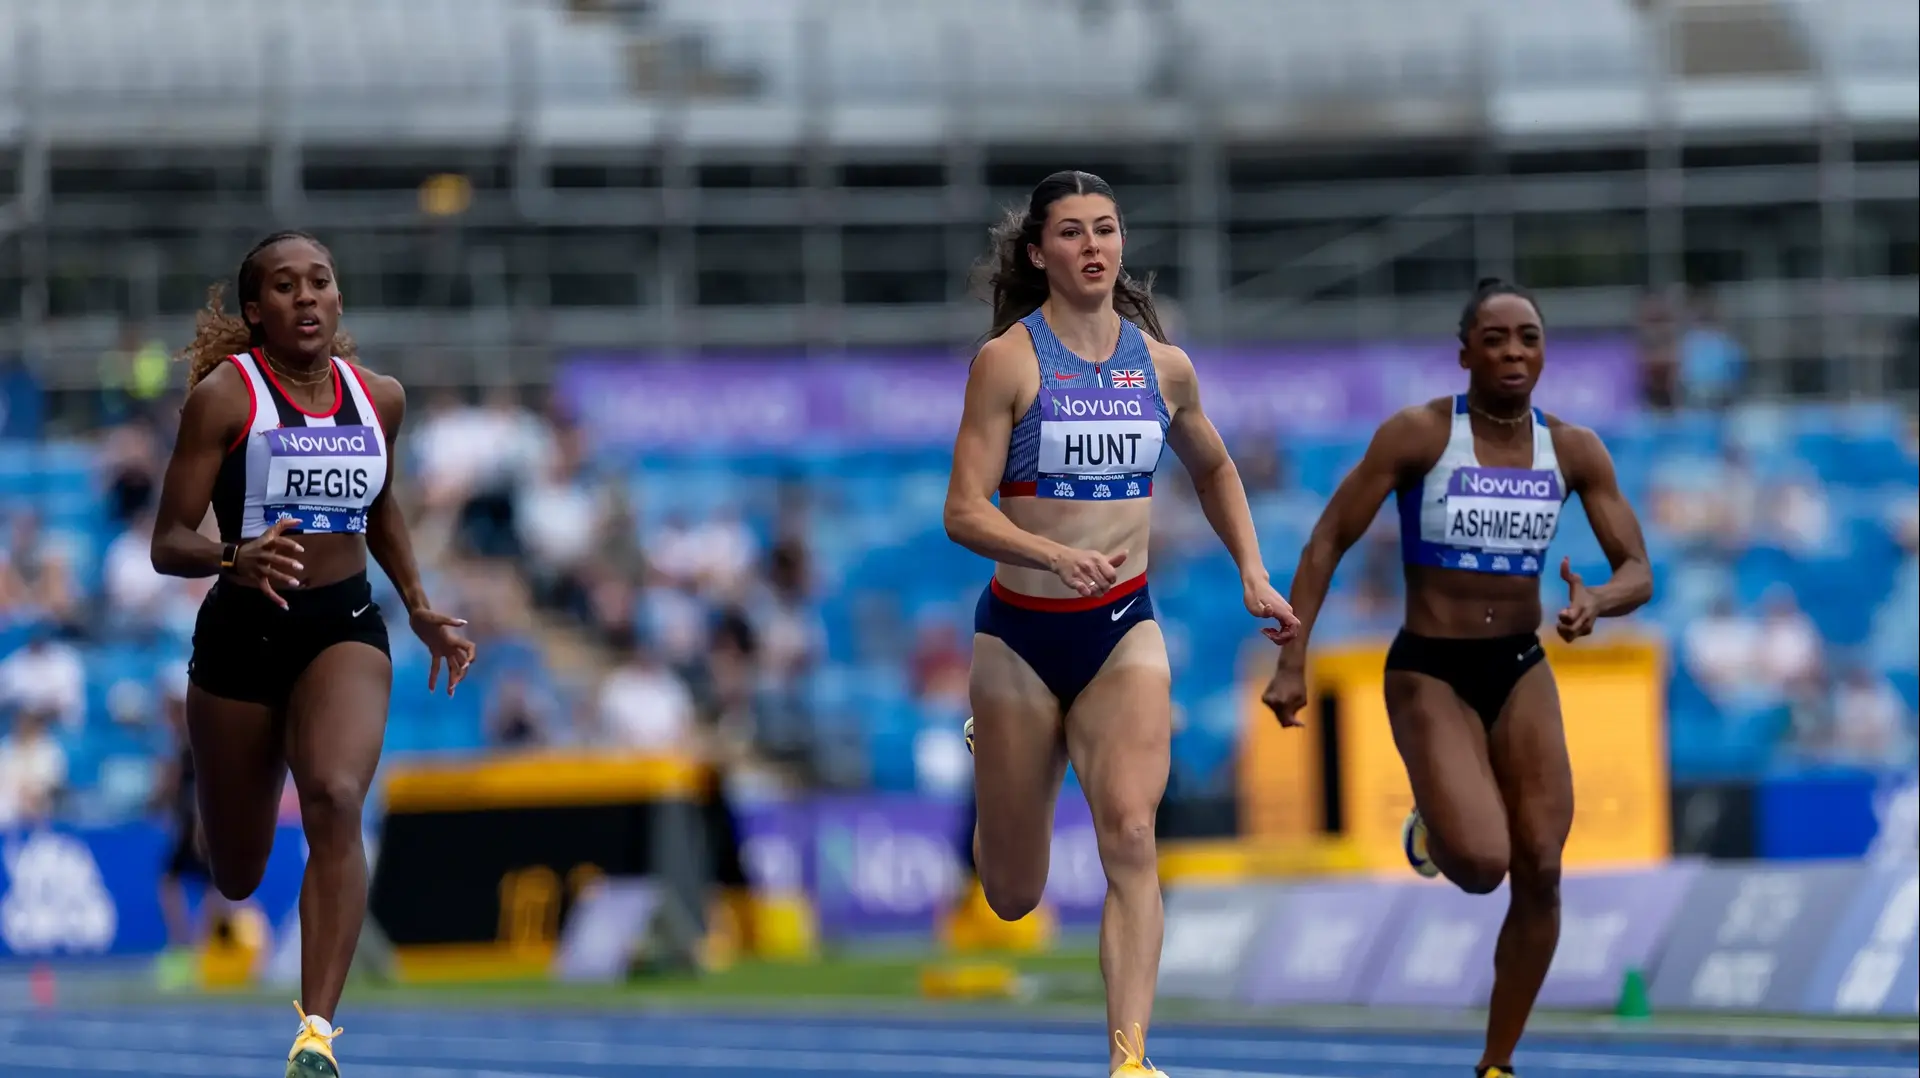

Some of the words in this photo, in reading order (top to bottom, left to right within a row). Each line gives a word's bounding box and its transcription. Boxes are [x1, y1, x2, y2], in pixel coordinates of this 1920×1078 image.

[1052, 395, 1142, 416] Novuna
[278, 433, 366, 452] Novuna
[1064, 433, 1142, 466] HUNT
[284, 468, 368, 499] REGIS
[1461, 471, 1551, 497] Novuna
[298, 505, 347, 513] BIRMINGHAM
[1451, 508, 1555, 540] ASHMEADE
